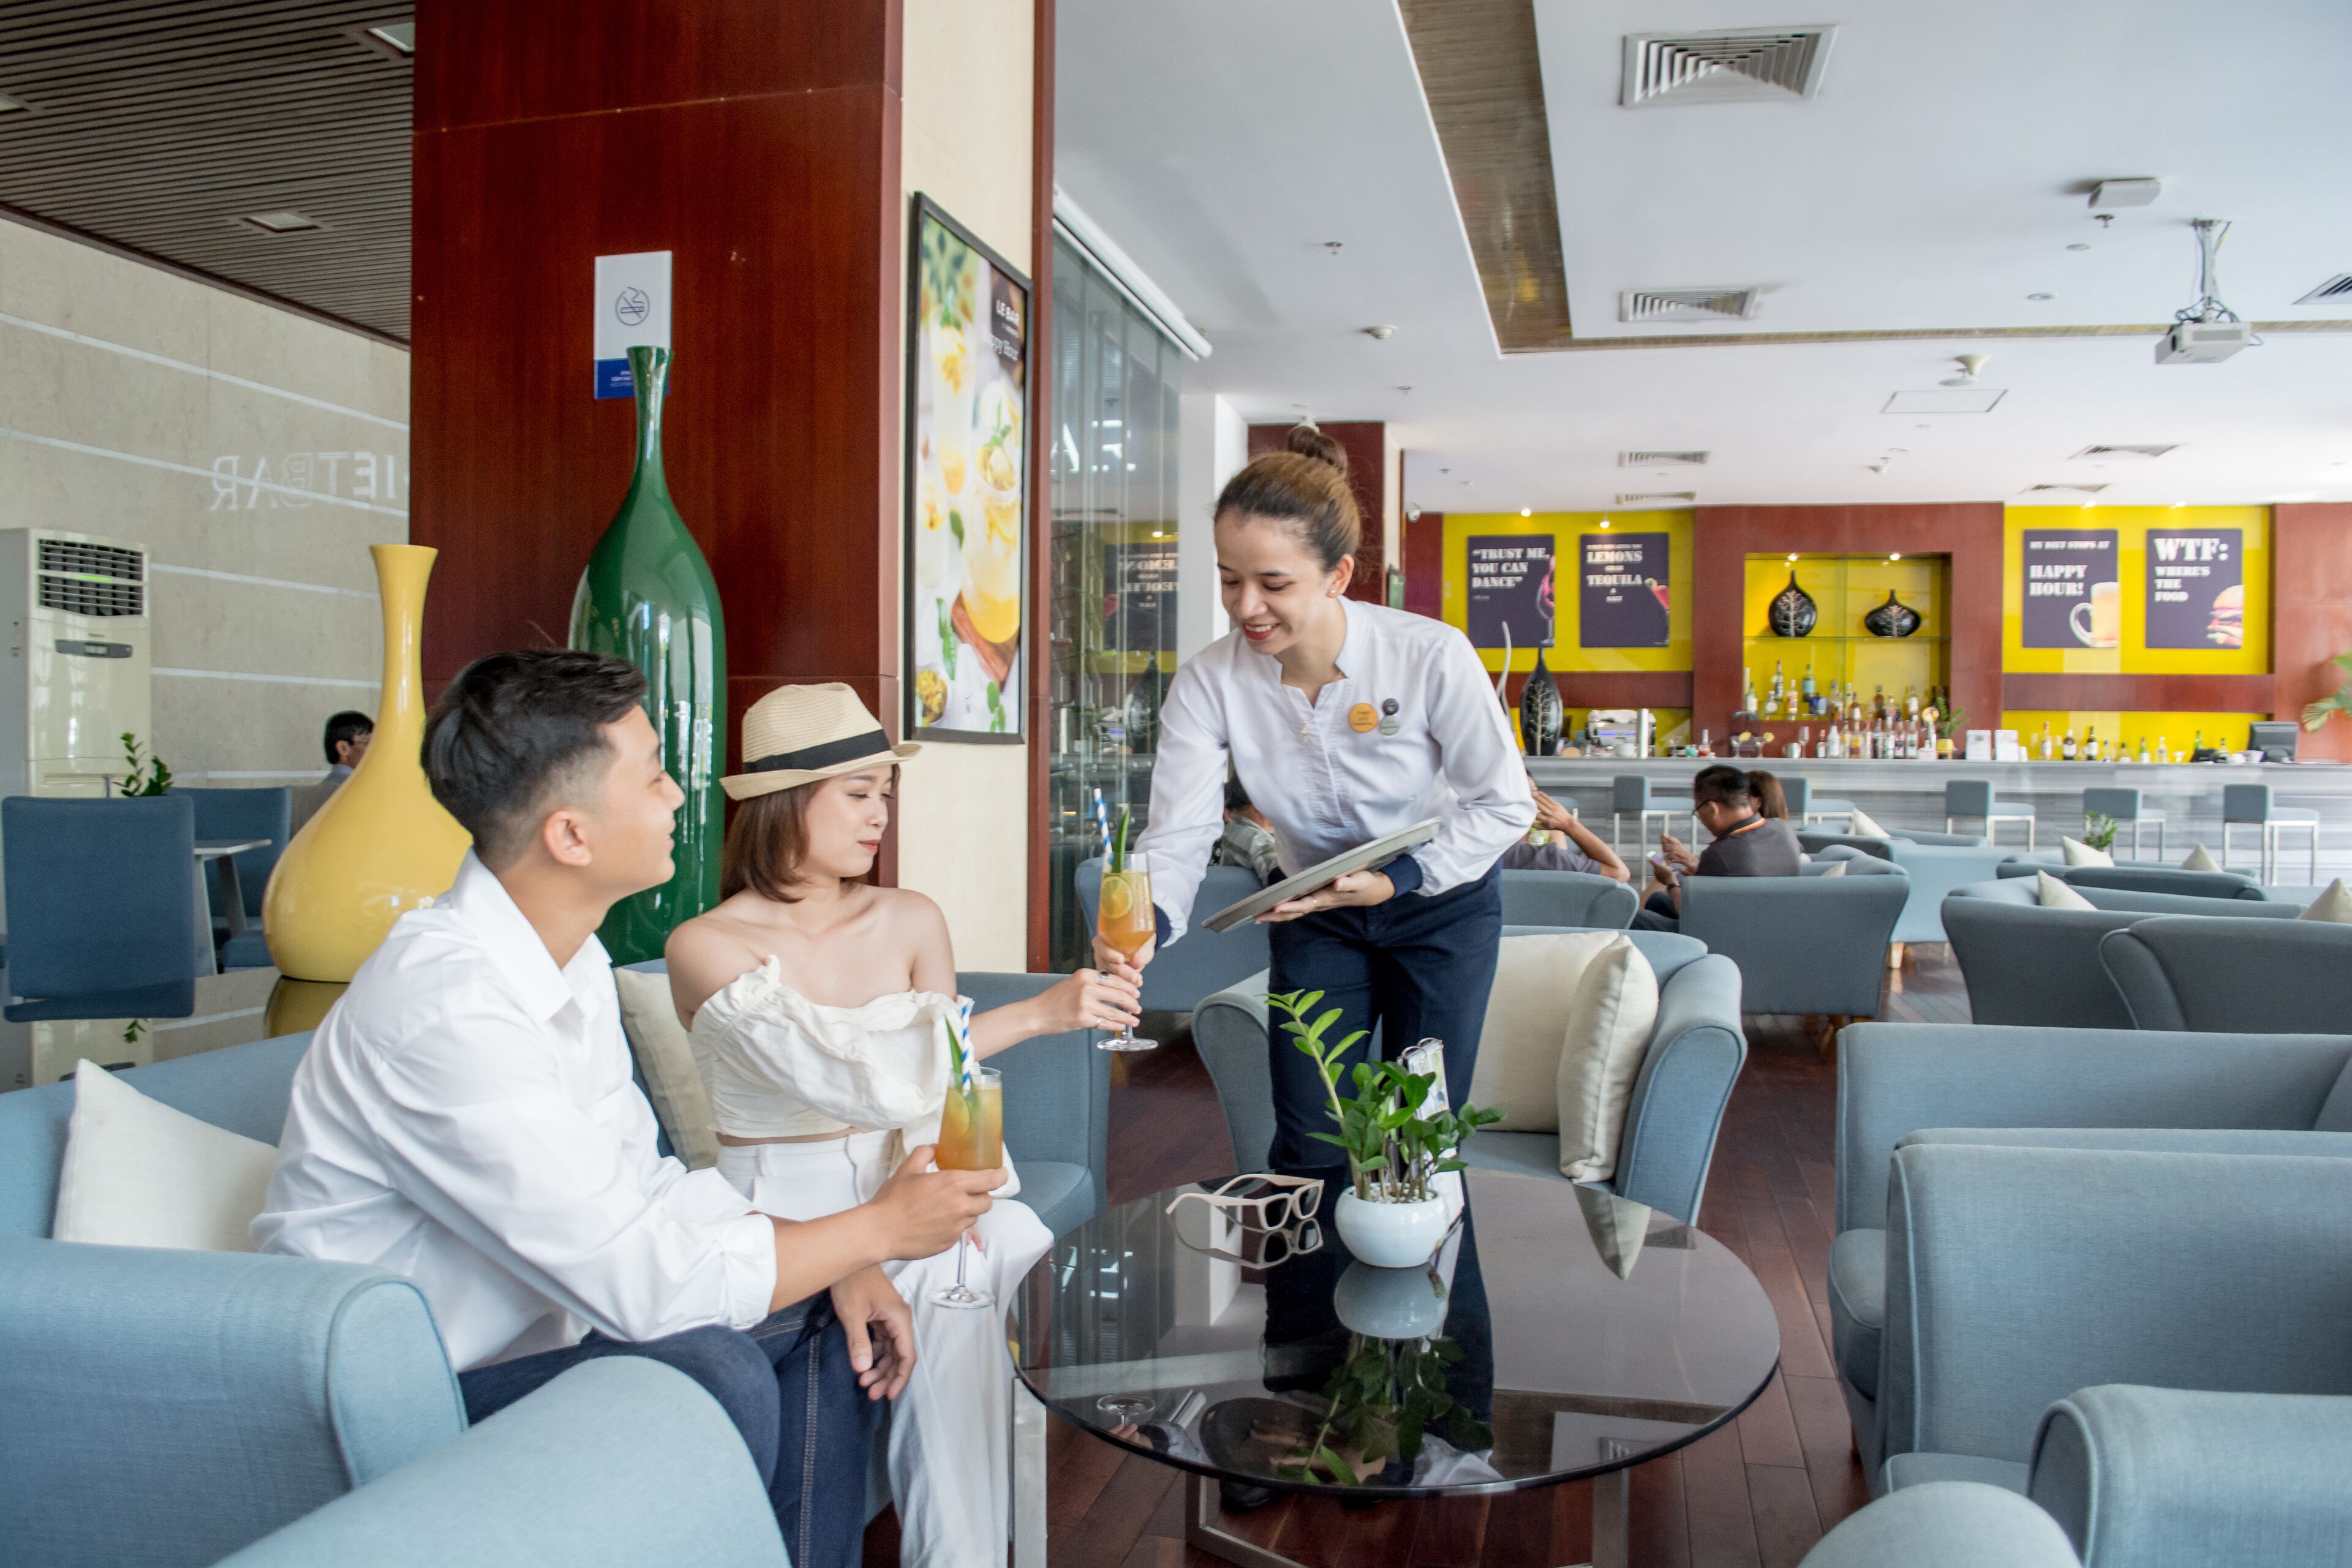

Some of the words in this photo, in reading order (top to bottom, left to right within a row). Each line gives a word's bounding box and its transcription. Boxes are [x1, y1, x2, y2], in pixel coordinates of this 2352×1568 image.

[2154, 538, 2229, 562] WTF:
[1586, 551, 1643, 564] LEMONS
[1472, 562, 1499, 574] YOU
[1500, 562, 1529, 573] CAN
[2029, 565, 2088, 580] HAPPY
[1586, 574, 1643, 587] TEQUILA
[2154, 578, 2182, 590] THE
[2028, 582, 2084, 597] HOUR!
[2154, 591, 2189, 603] FOOD
